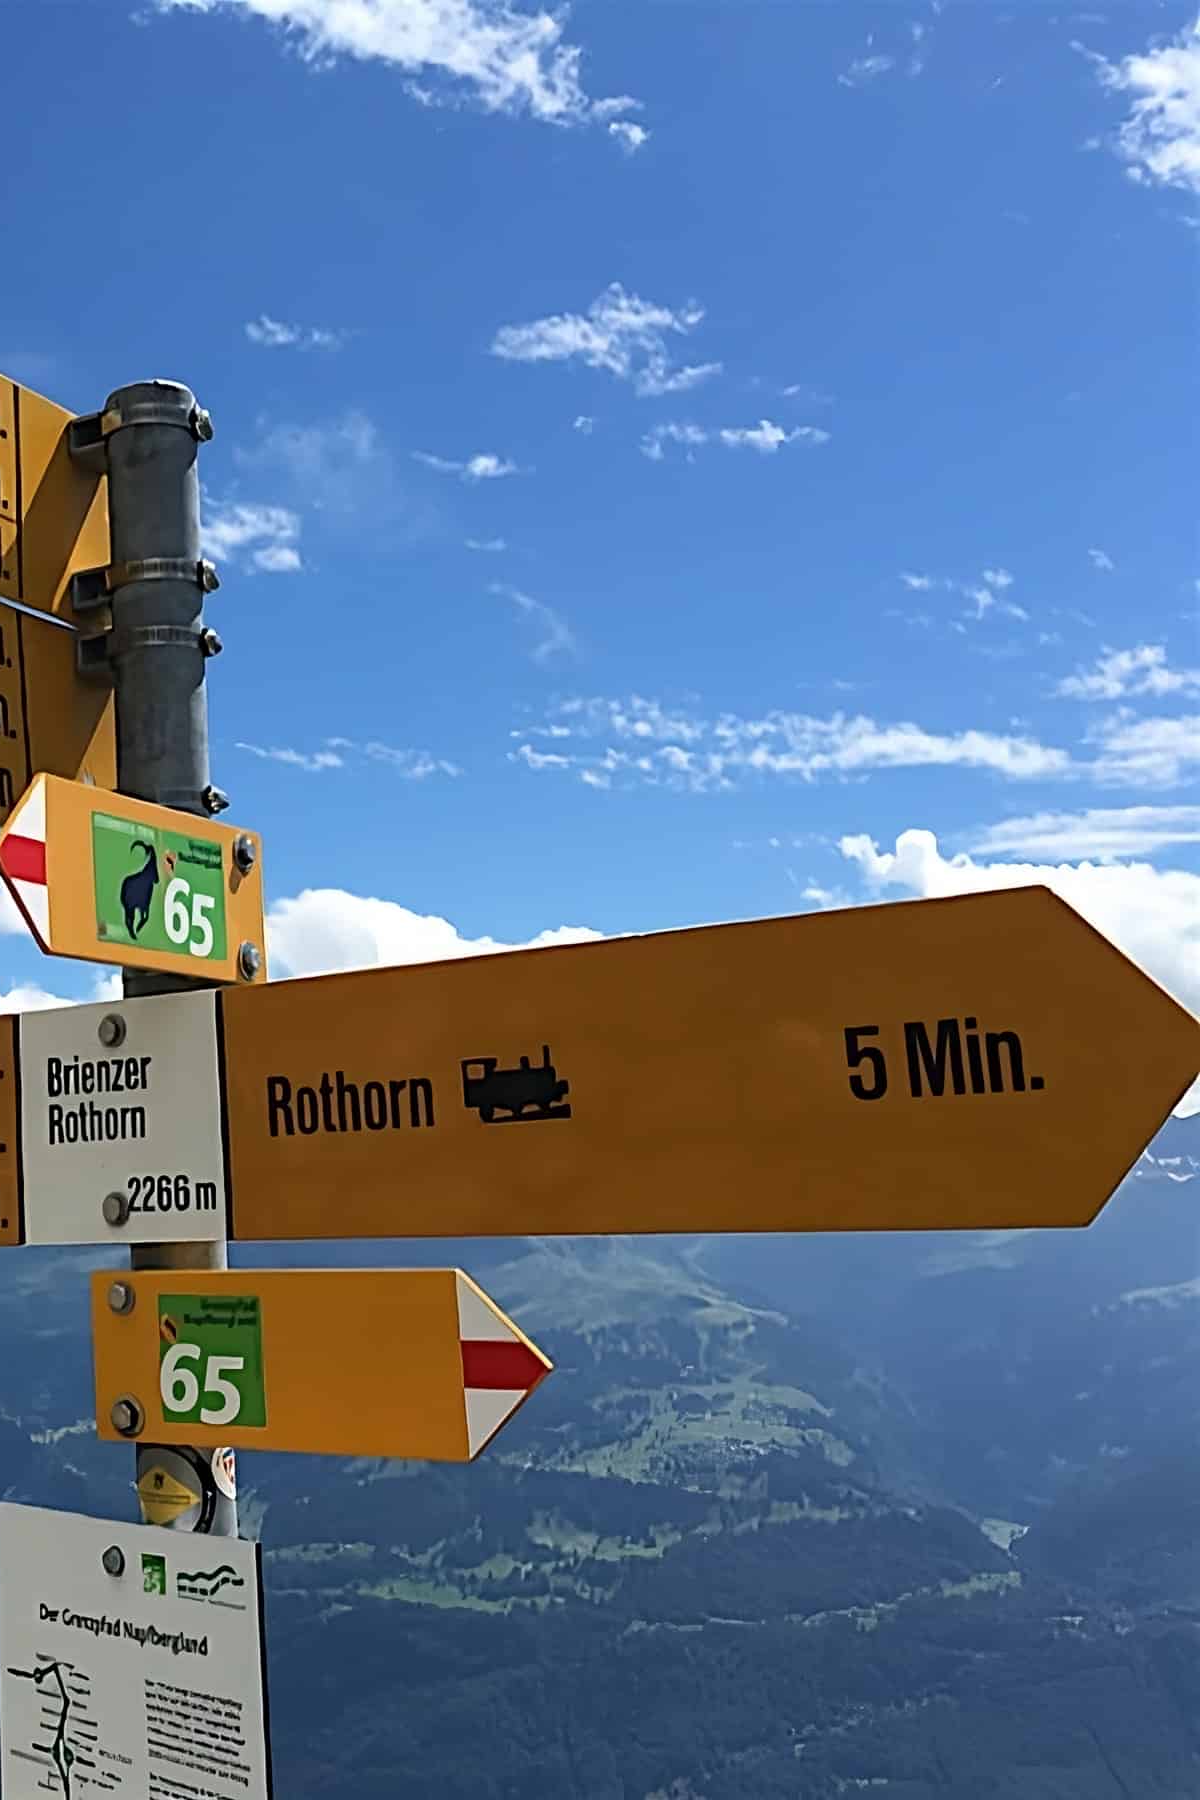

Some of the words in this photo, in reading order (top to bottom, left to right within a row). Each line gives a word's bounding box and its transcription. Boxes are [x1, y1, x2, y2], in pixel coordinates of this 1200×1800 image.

[164, 877, 216, 957] 65
[47, 1055, 152, 1098] Brienzer
[844, 1025, 888, 1100] 5
[903, 1016, 1045, 1098] Min.
[48, 1101, 146, 1145] Rothorn
[266, 1070, 435, 1137] Rothorn
[127, 1174, 190, 1212] 2266
[195, 1182, 217, 1211] m
[160, 1343, 244, 1425] 65
